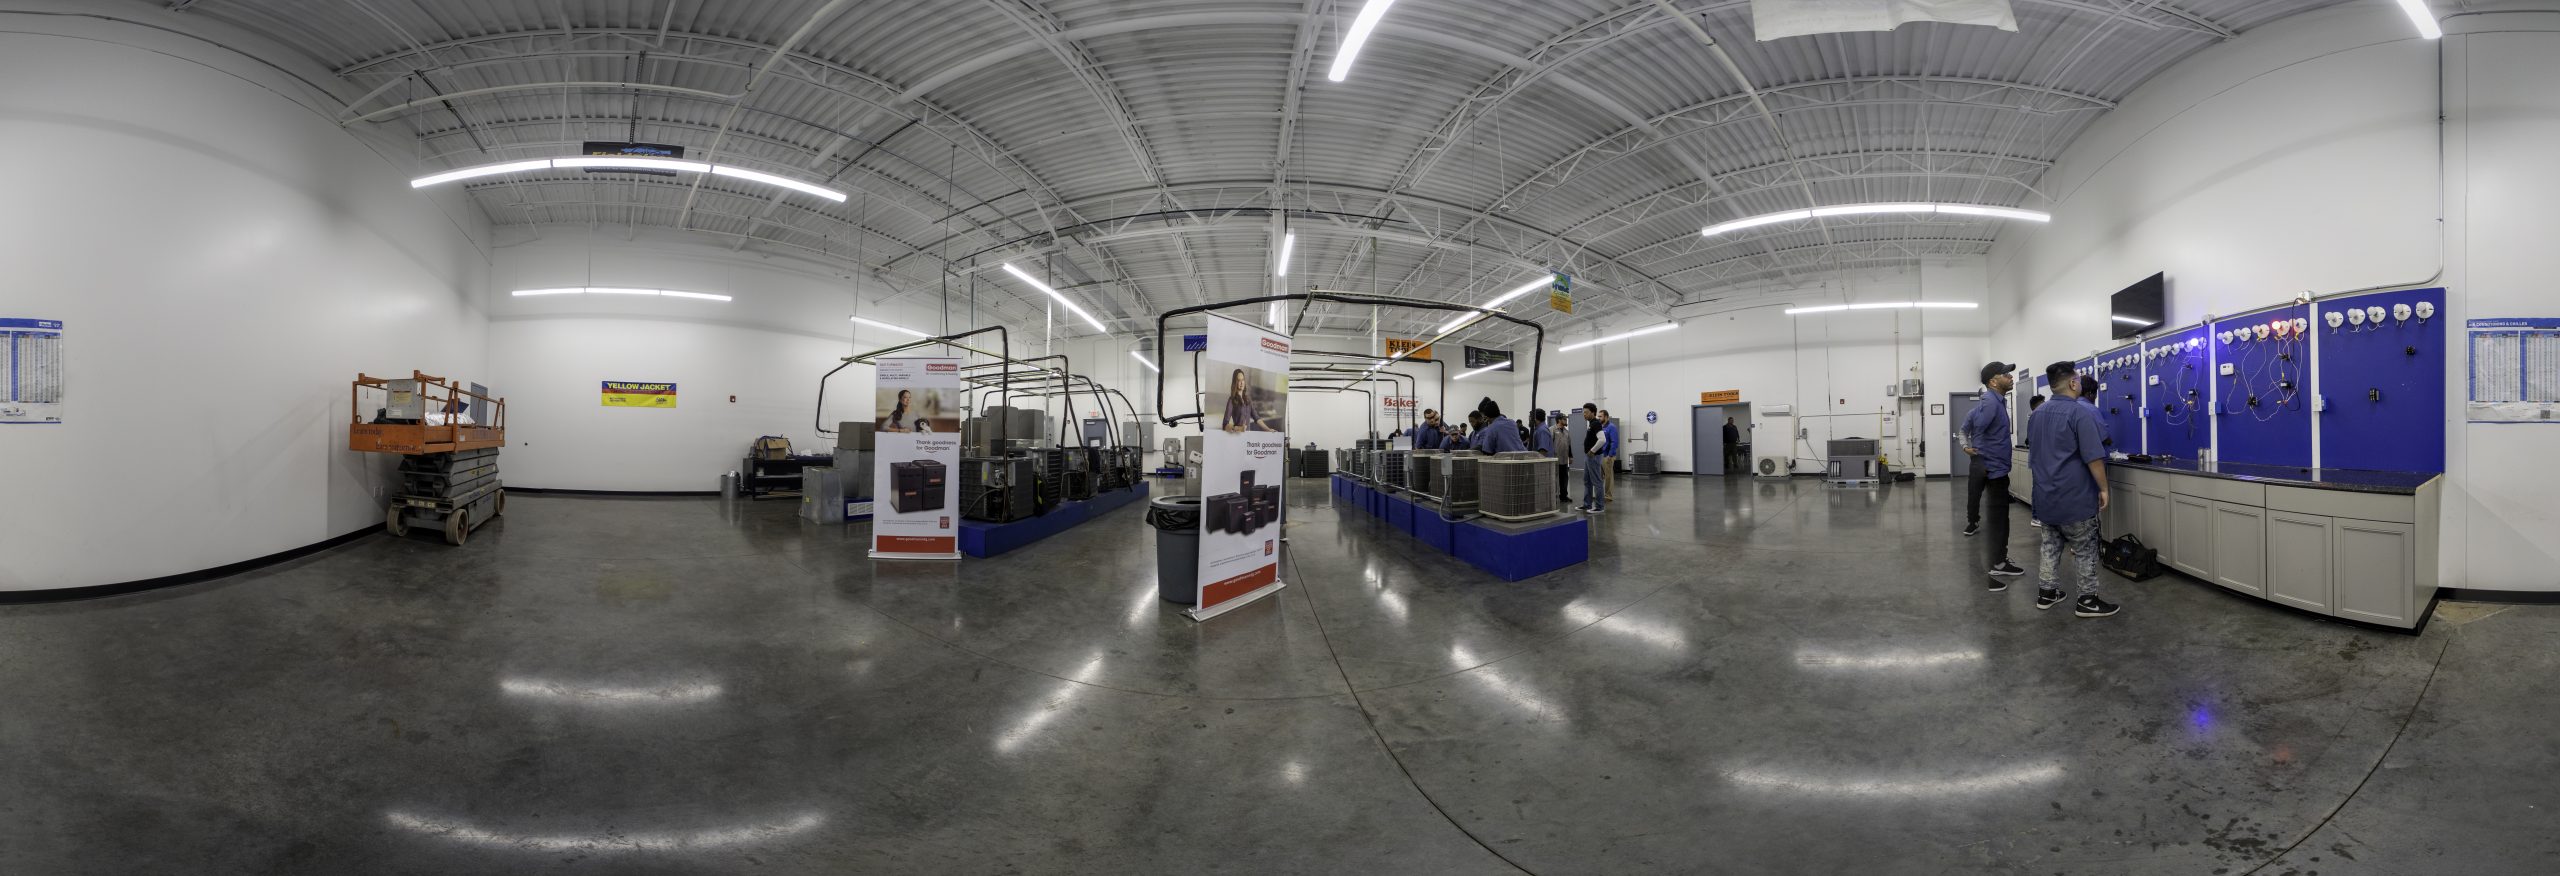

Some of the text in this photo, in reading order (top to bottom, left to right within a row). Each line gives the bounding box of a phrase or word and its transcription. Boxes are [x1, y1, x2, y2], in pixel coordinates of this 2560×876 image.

[1262, 339, 1288, 352] Goodman
[607, 382, 639, 390] YELLOW
[1384, 397, 1419, 408] Baker
